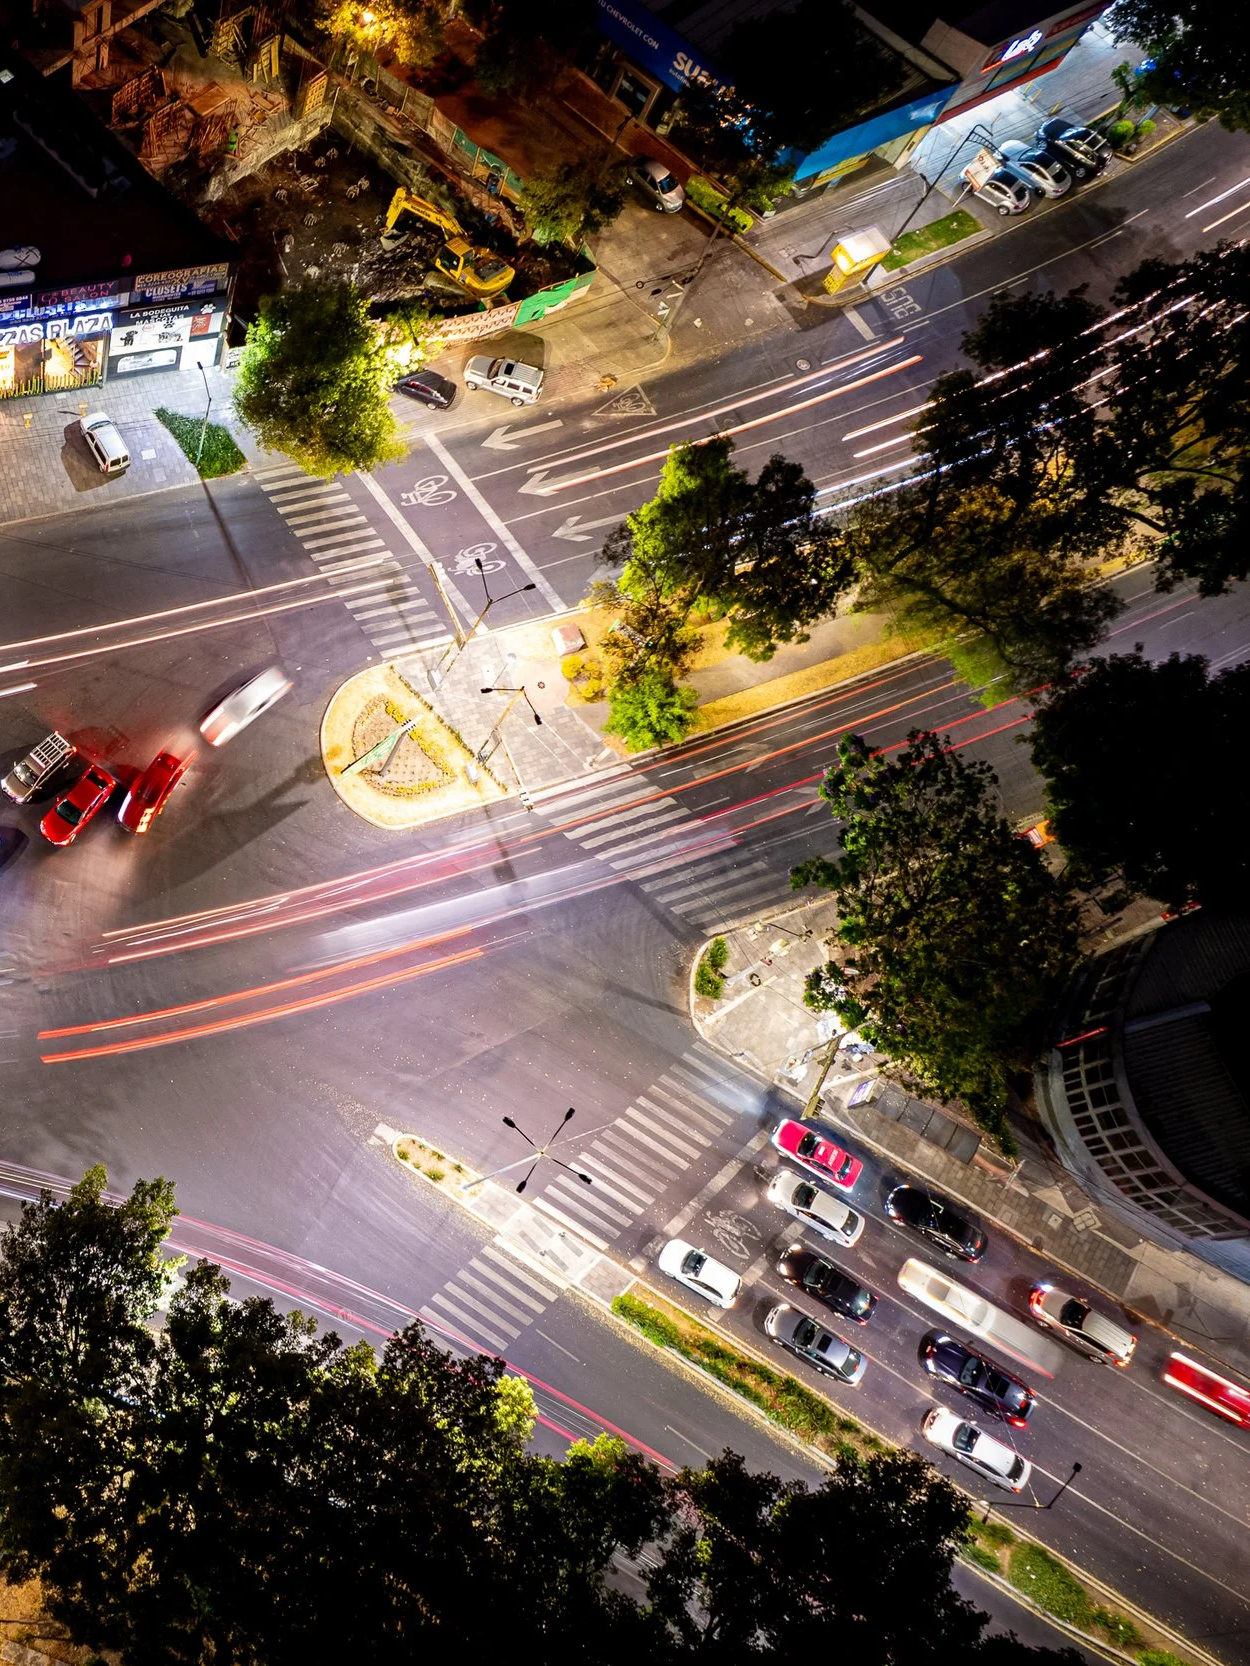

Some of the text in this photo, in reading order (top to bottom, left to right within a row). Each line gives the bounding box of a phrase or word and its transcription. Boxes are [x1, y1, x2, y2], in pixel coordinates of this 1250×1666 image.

[606, 4, 644, 37] CHEVROLET
[643, 34, 660, 50] CON
[61, 281, 115, 297] BEAUTY
[64, 290, 109, 303] SALON
[130, 304, 190, 319] LA BODEGUITA
[135, 313, 185, 326] MASCOTAS
[49, 315, 112, 340] PLAZA
